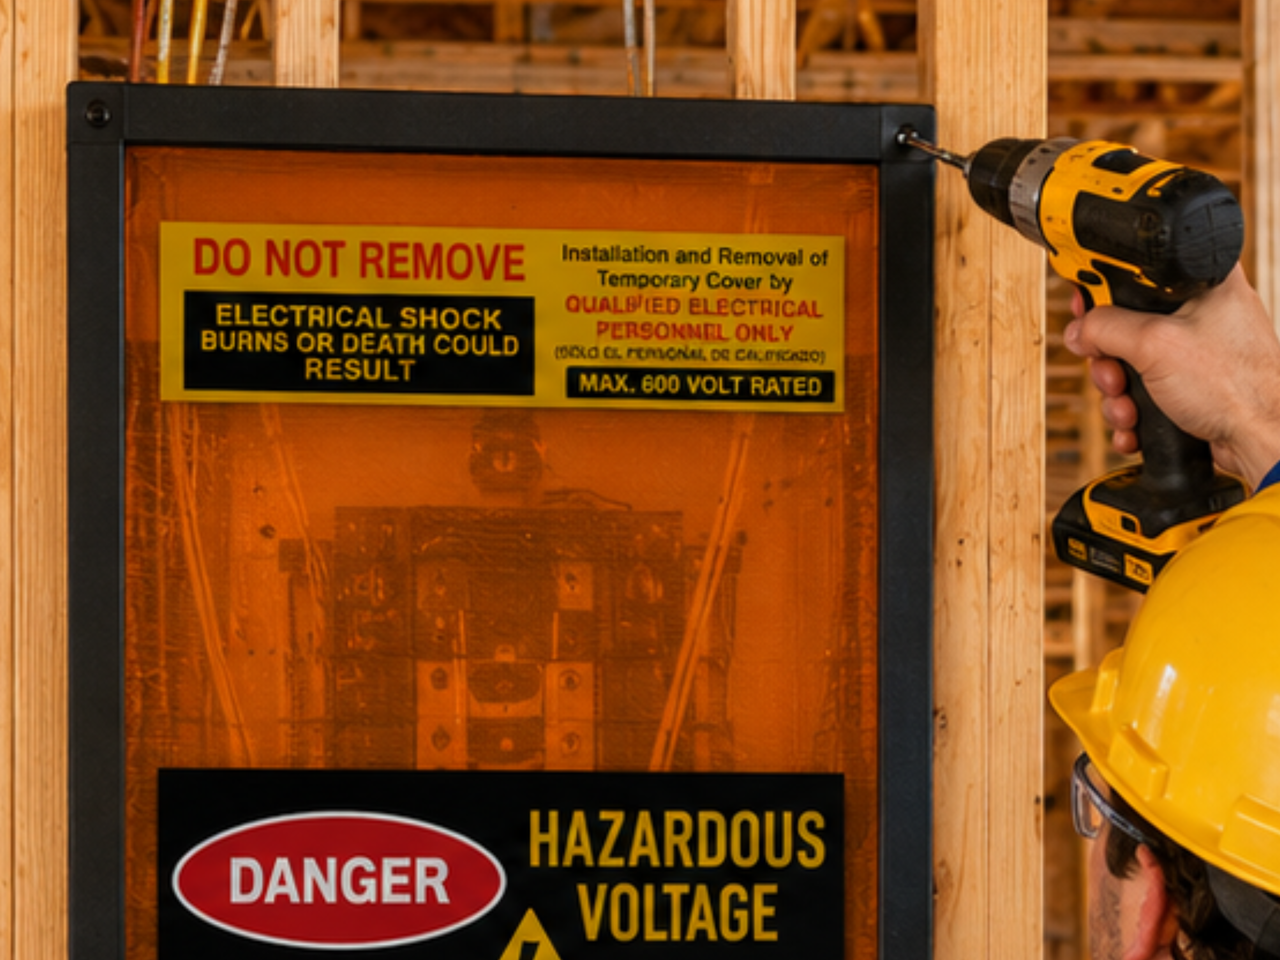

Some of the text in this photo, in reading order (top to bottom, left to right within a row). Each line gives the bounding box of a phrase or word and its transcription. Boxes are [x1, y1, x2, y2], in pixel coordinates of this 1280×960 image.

[193, 237, 526, 282] DO NOT REMOVE
[562, 244, 829, 267] Installation and Removal of
[596, 269, 794, 296] Temporary Cover by
[215, 303, 502, 331] ELECTRICAL SHOCK
[688, 298, 824, 319] ELECTRICAL
[201, 330, 520, 357] BURNS OR DEATH COULD
[595, 321, 795, 343] PERSONNEL ONLY
[305, 357, 416, 381] RESULT
[579, 373, 822, 397] MAX. 600 VOLT RATED
[529, 809, 826, 868] HAZARDOUS
[229, 856, 451, 905] DANGER
[576, 883, 779, 942] VOLTAGE
